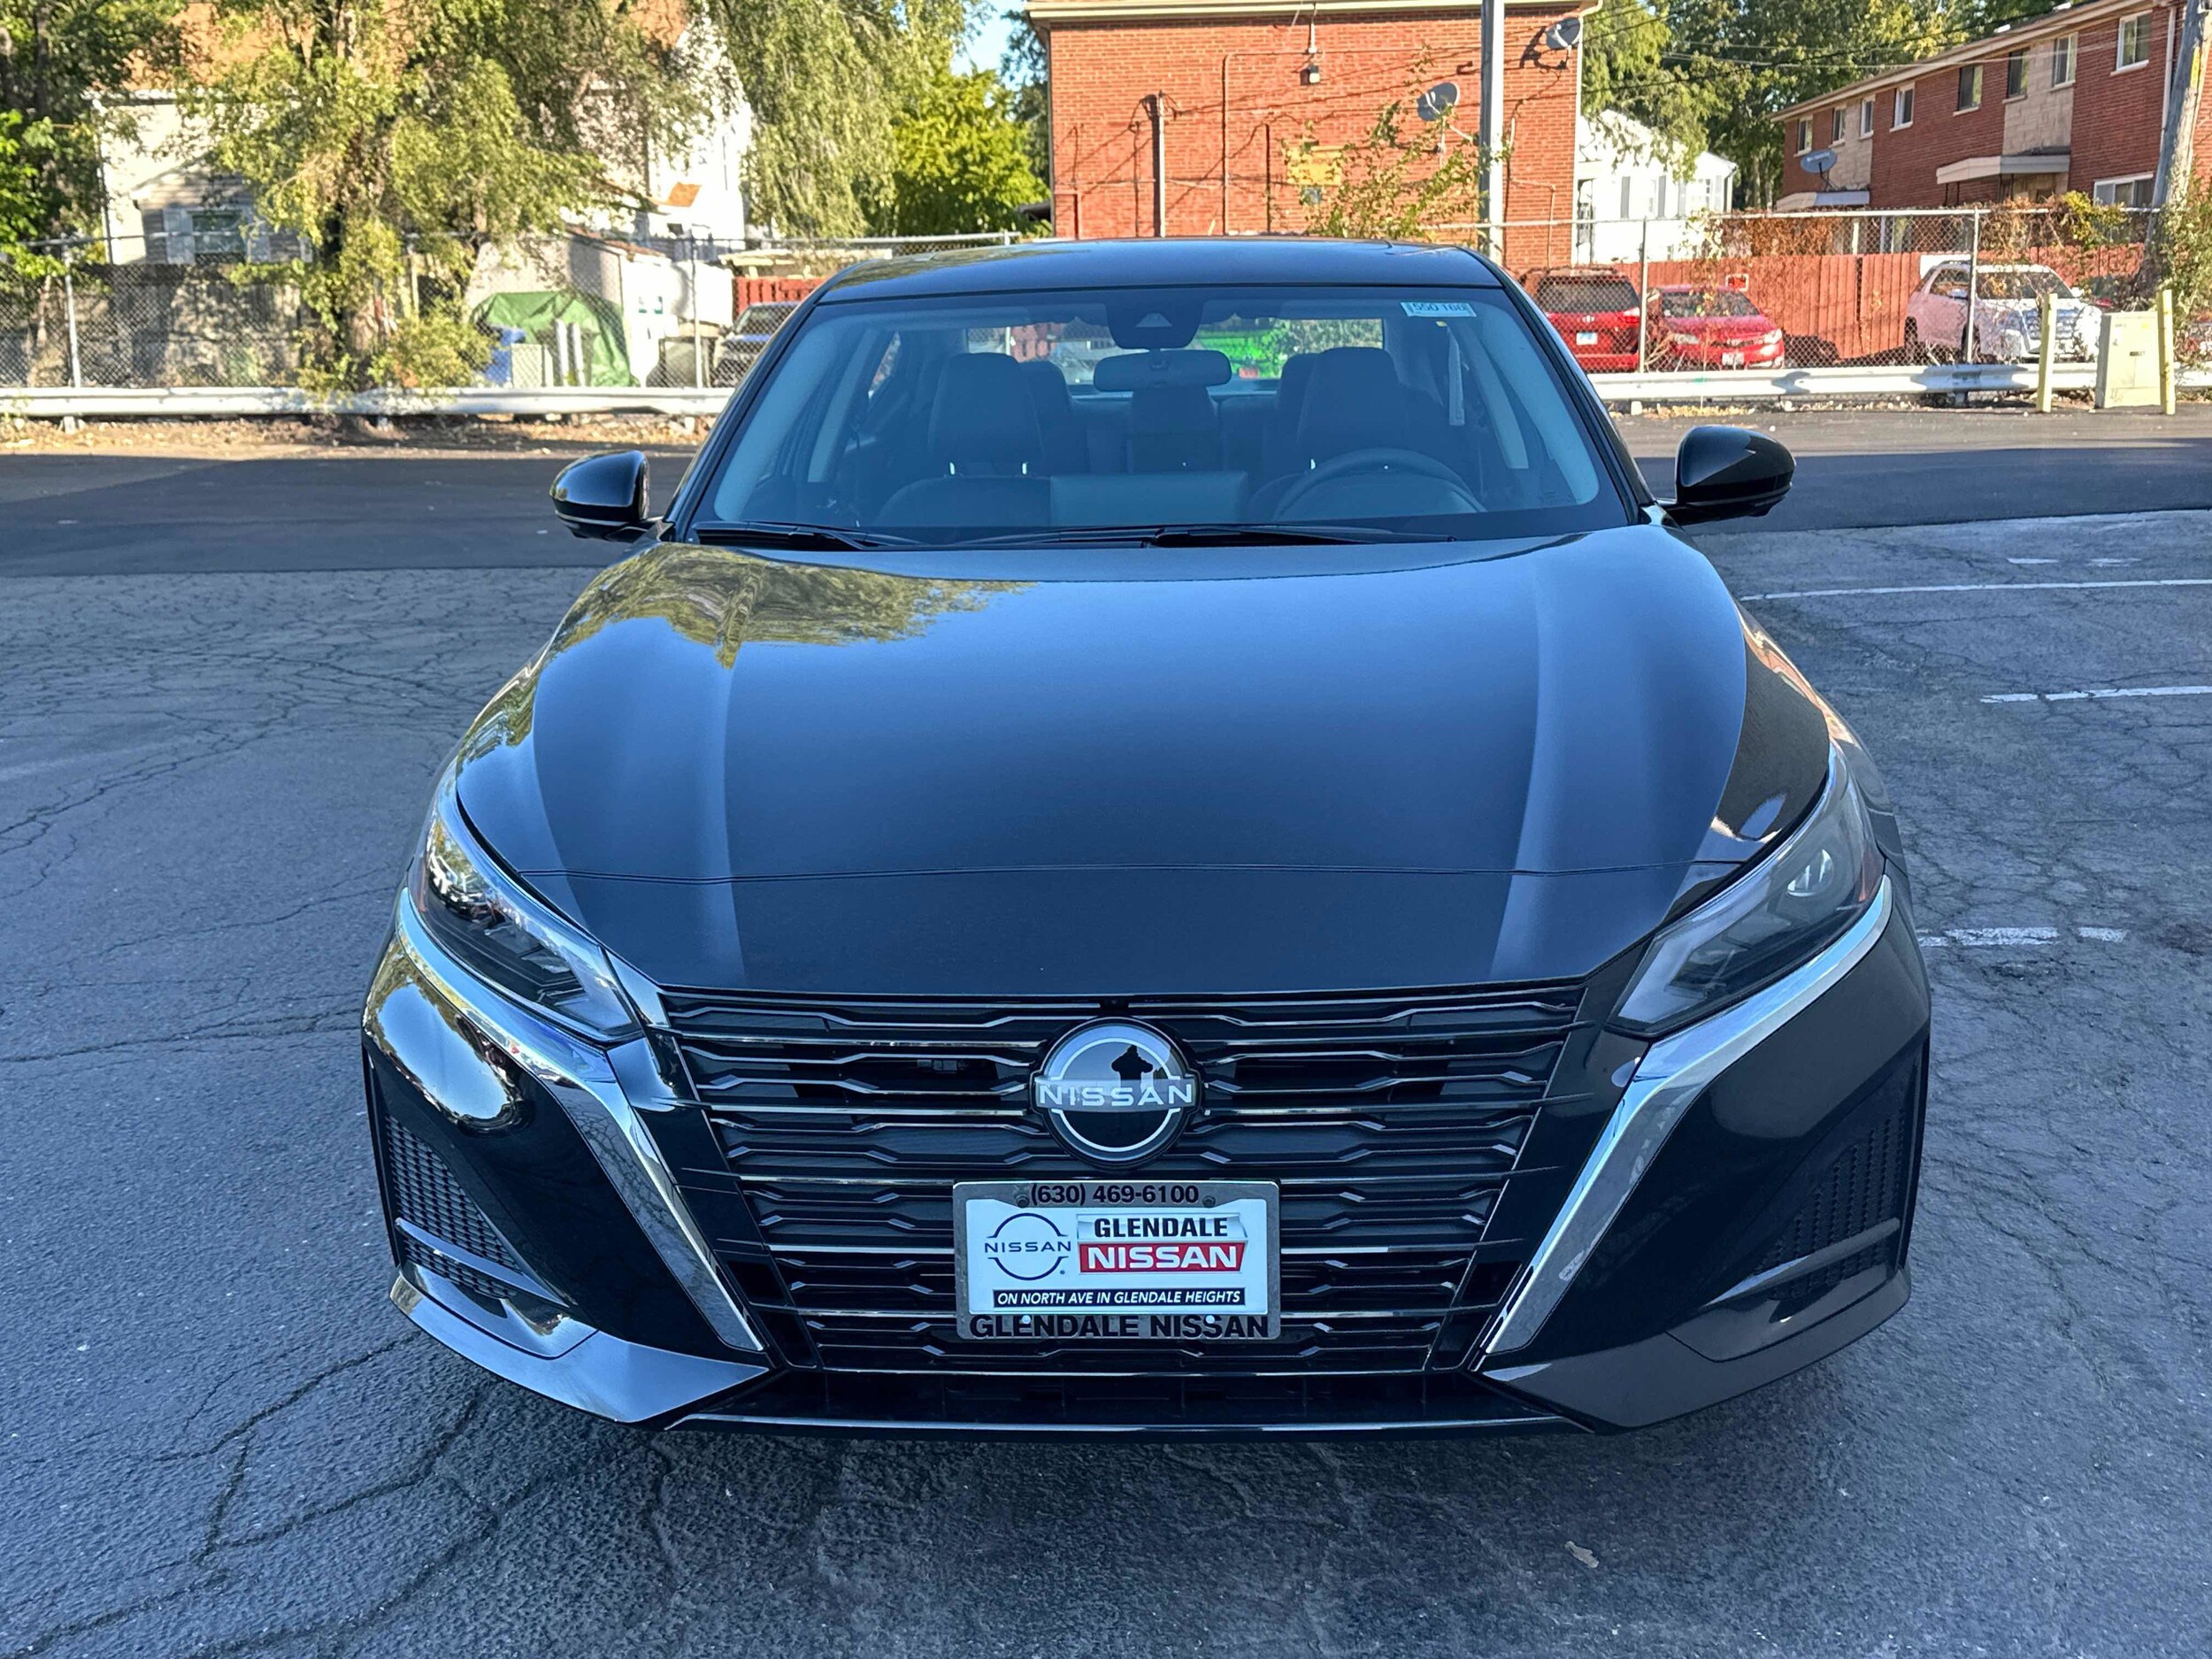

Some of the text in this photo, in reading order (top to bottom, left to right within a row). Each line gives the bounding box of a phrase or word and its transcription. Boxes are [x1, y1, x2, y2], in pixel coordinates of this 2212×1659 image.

[1039, 1083, 1192, 1107] NISSAN
[1030, 1184, 1200, 1206] (630) 469-6100
[1094, 1217, 1228, 1238] GLENDALE
[984, 1240, 1071, 1254] NISSAN
[1088, 1245, 1237, 1269] NISSAN
[997, 1290, 1241, 1305] ON NORTH AVE IN GLENDALE HEIGHTS
[969, 1315, 1270, 1339] GLENDALE NISSAN
